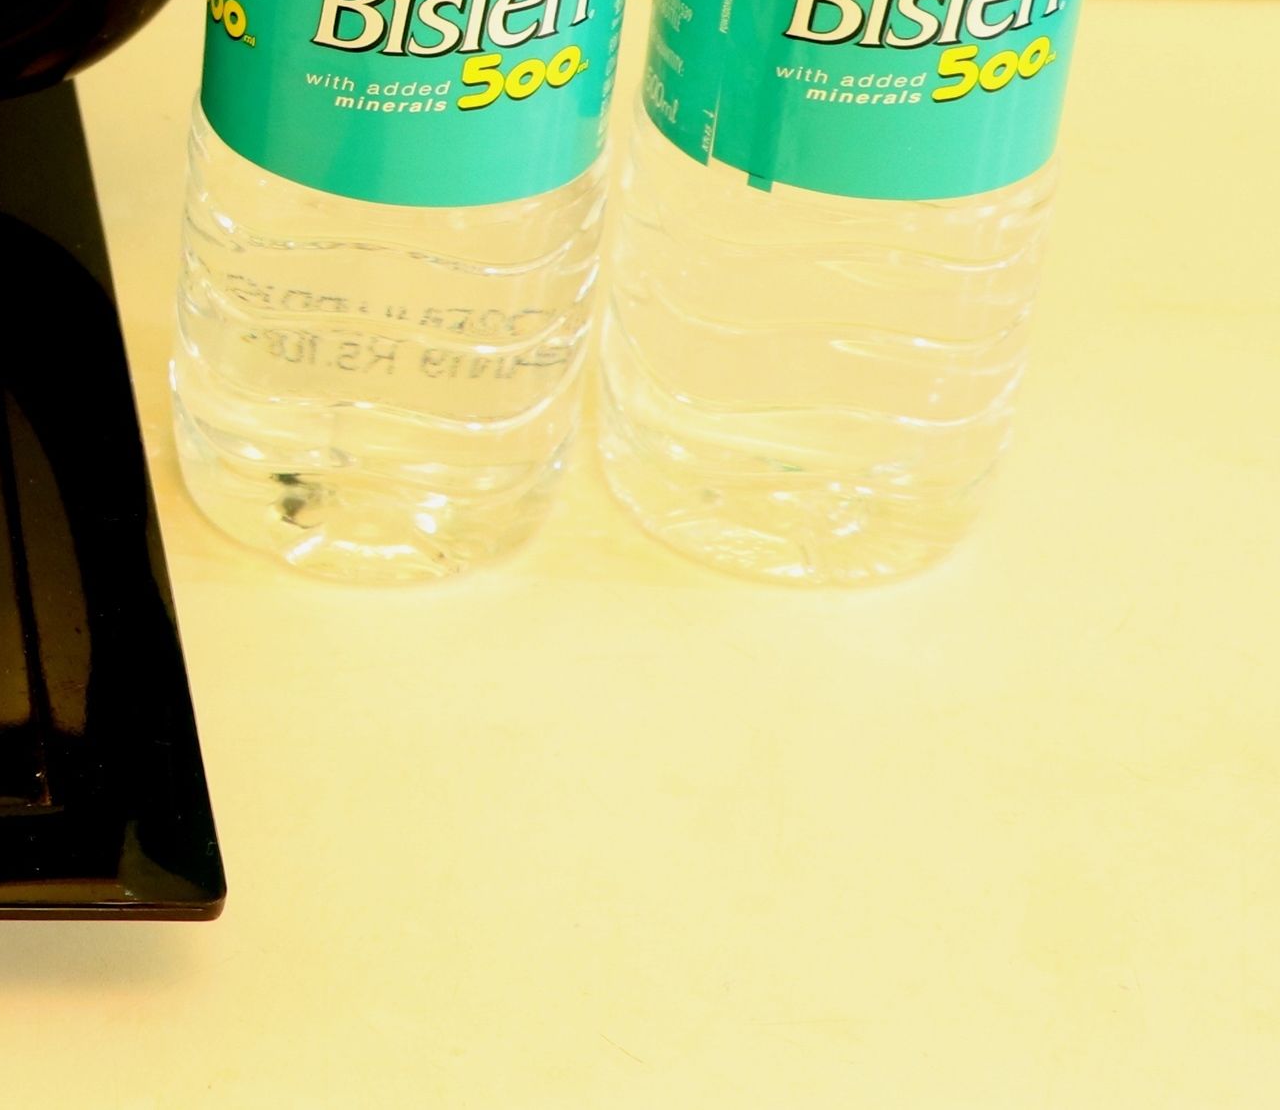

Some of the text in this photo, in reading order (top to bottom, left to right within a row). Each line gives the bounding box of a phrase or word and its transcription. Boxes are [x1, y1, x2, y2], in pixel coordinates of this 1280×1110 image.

[305, 72, 452, 97] with added
[775, 65, 927, 88] with added
[334, 94, 448, 113] minerals
[806, 86, 922, 105] minerals
